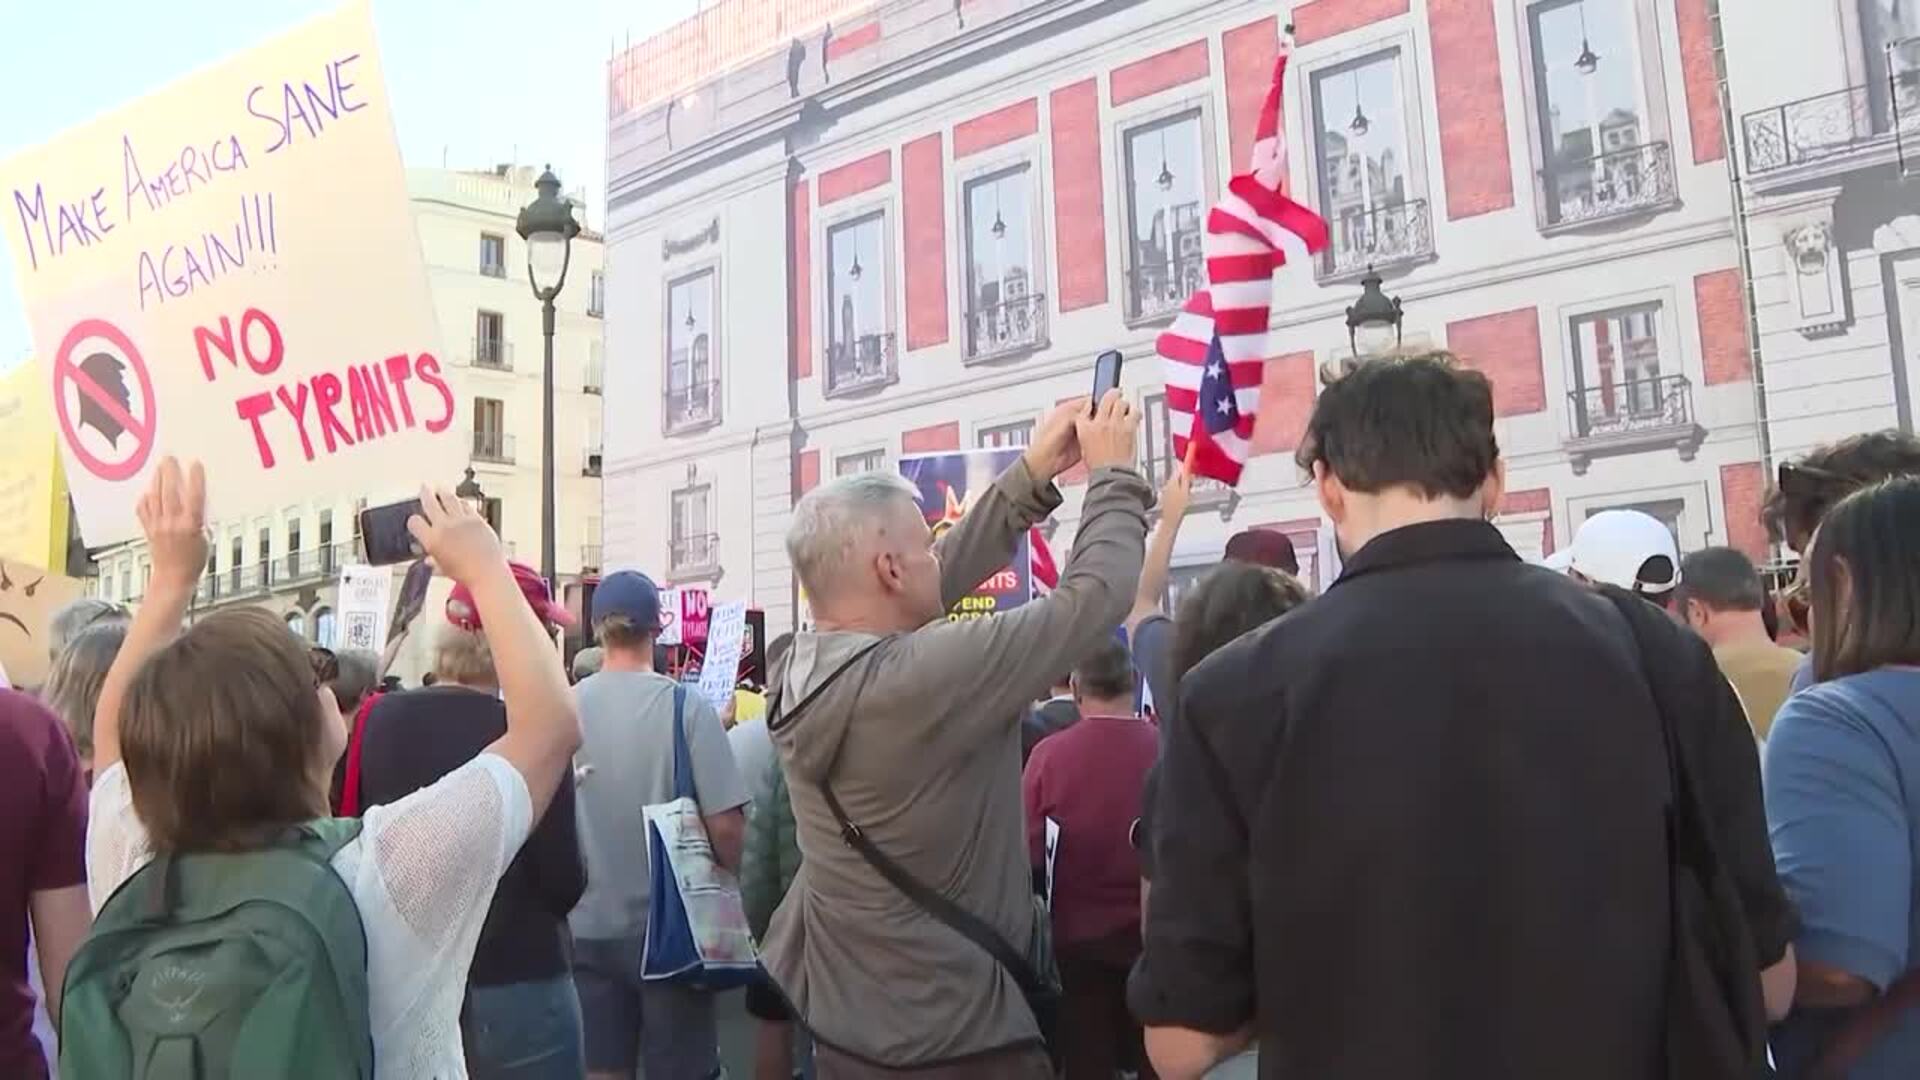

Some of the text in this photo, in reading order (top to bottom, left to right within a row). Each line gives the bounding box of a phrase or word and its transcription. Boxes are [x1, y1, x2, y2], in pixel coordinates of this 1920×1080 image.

[14, 54, 368, 270] MAKE AMERICA SANE
[193, 307, 285, 382] NO
[236, 352, 456, 470] TYRANTS
[684, 591, 708, 619] NO
